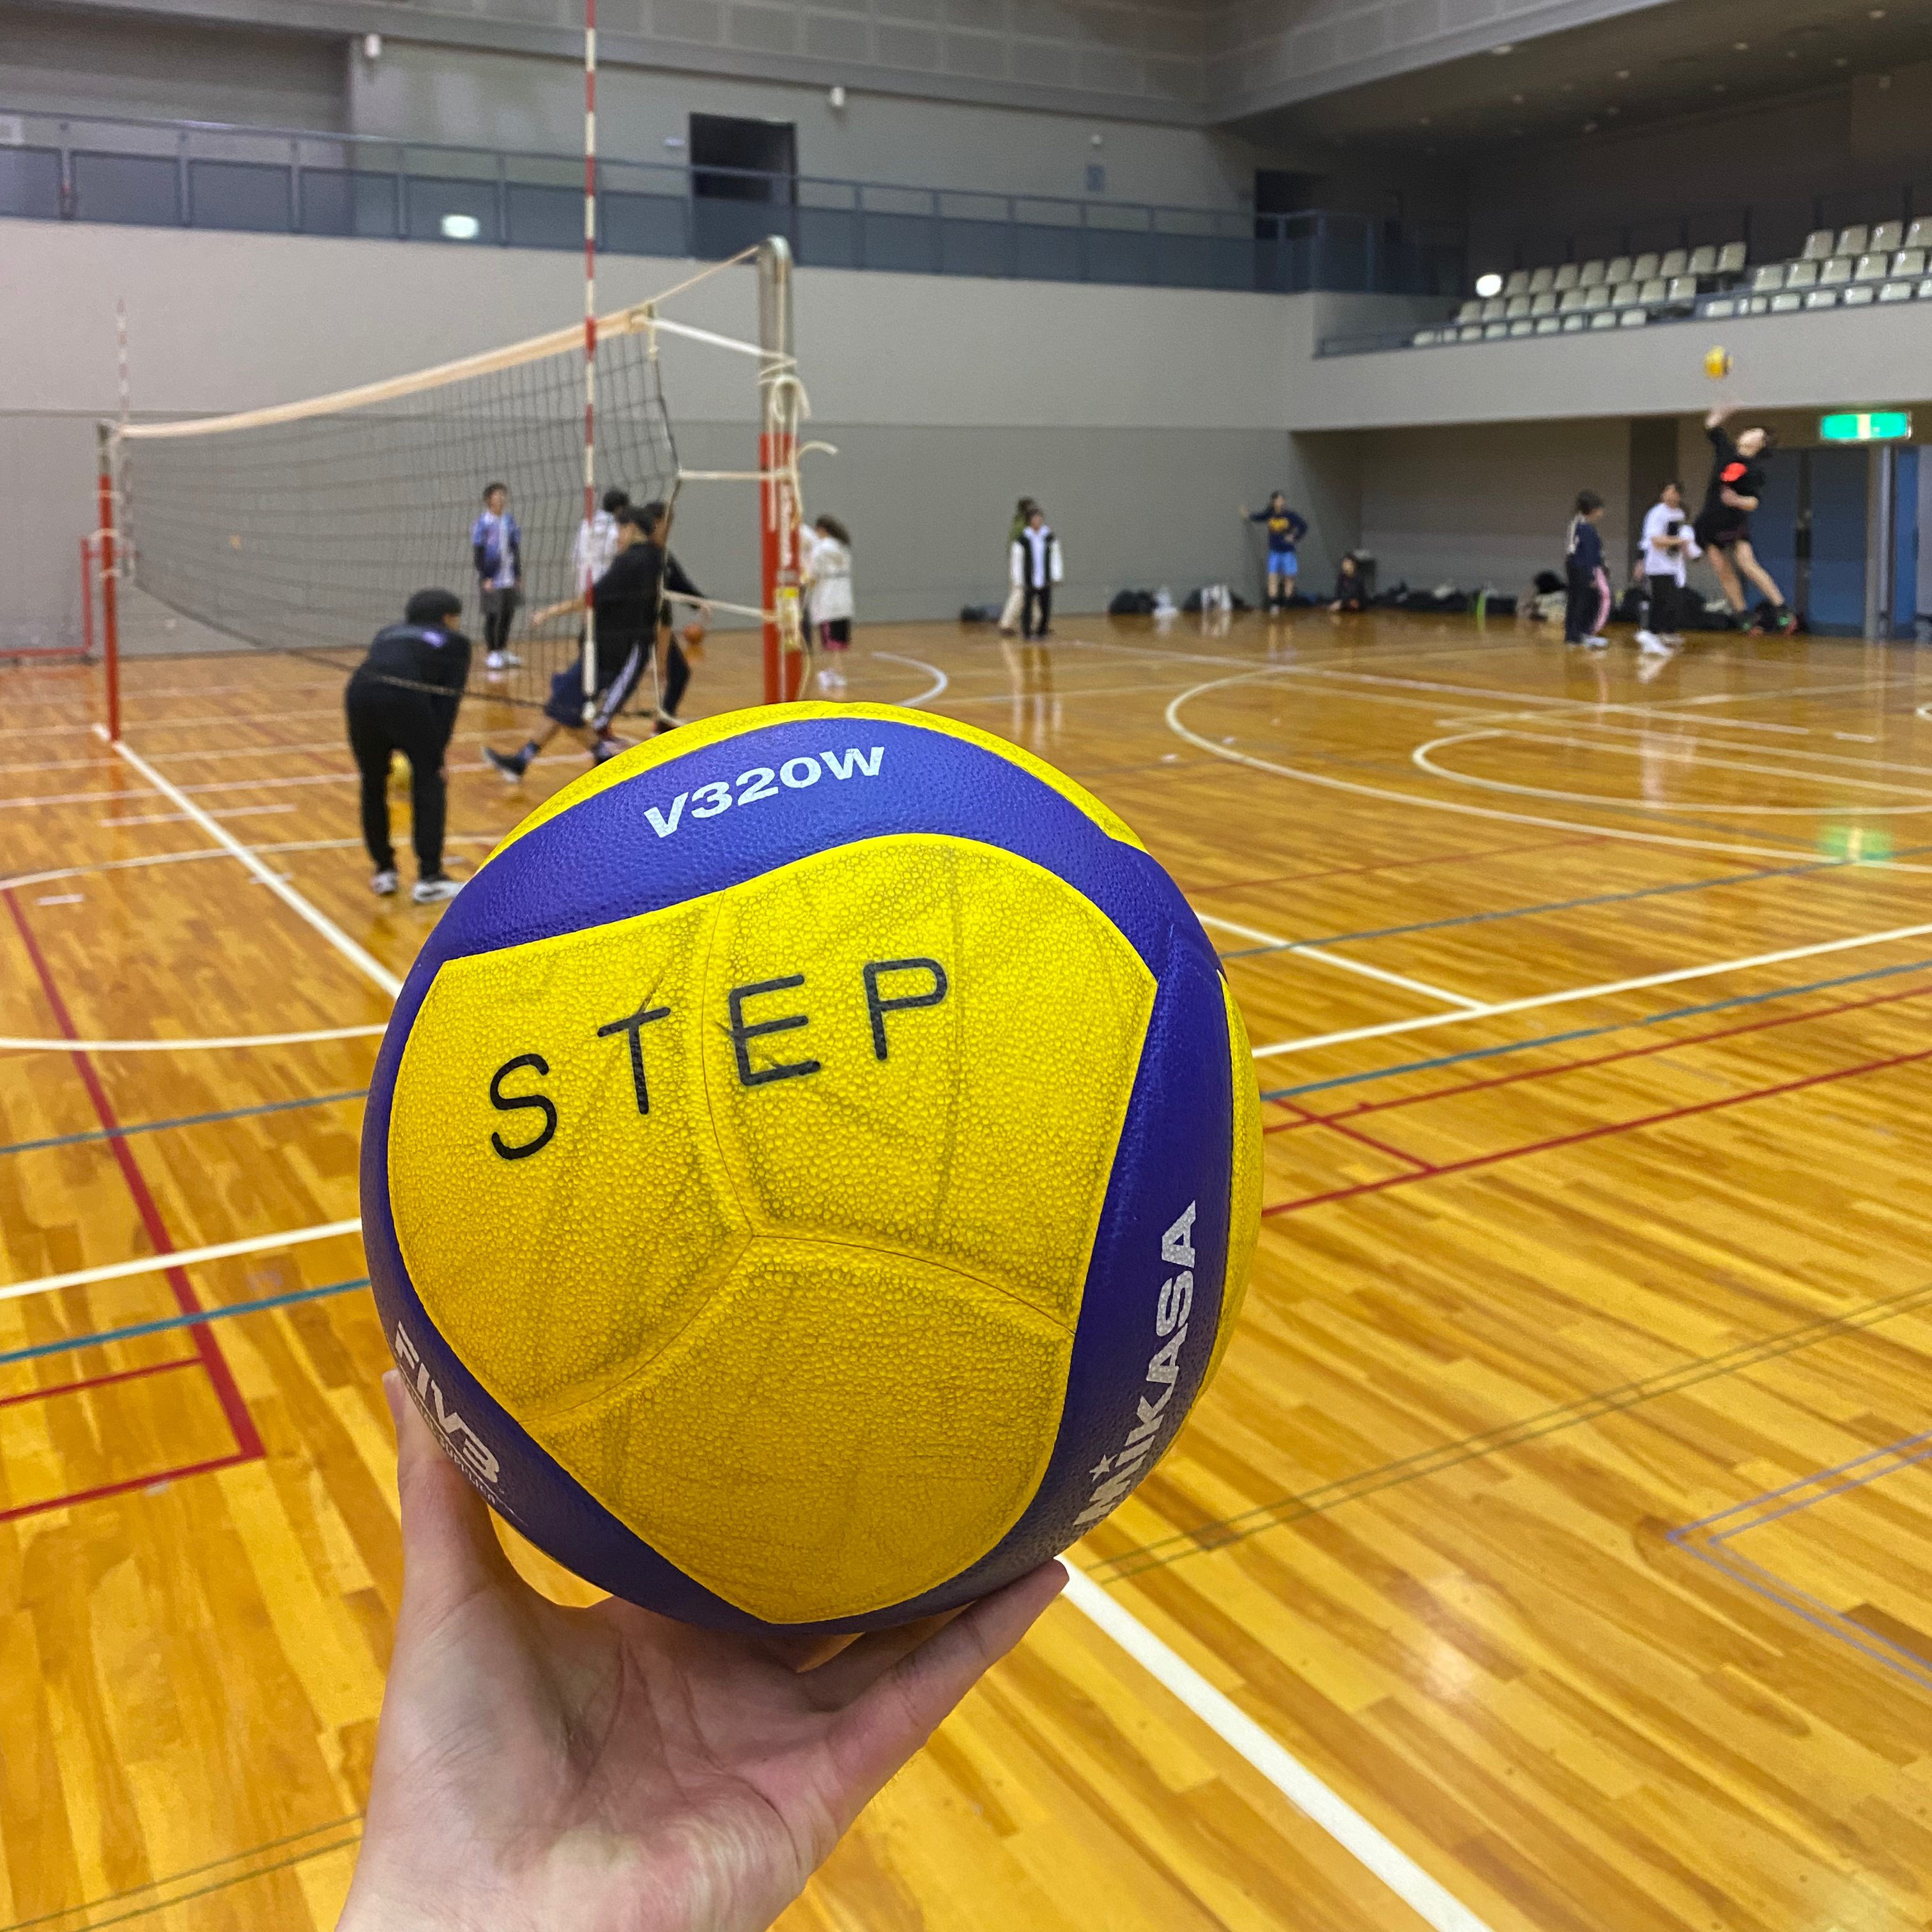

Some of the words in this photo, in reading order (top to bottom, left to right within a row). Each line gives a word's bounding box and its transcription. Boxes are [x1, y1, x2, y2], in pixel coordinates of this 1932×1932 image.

[643, 746, 885, 838] V320W
[489, 957, 948, 1161] STEP
[395, 1320, 500, 1483] FIVB
[1073, 1199, 1197, 1526] MIKASA
